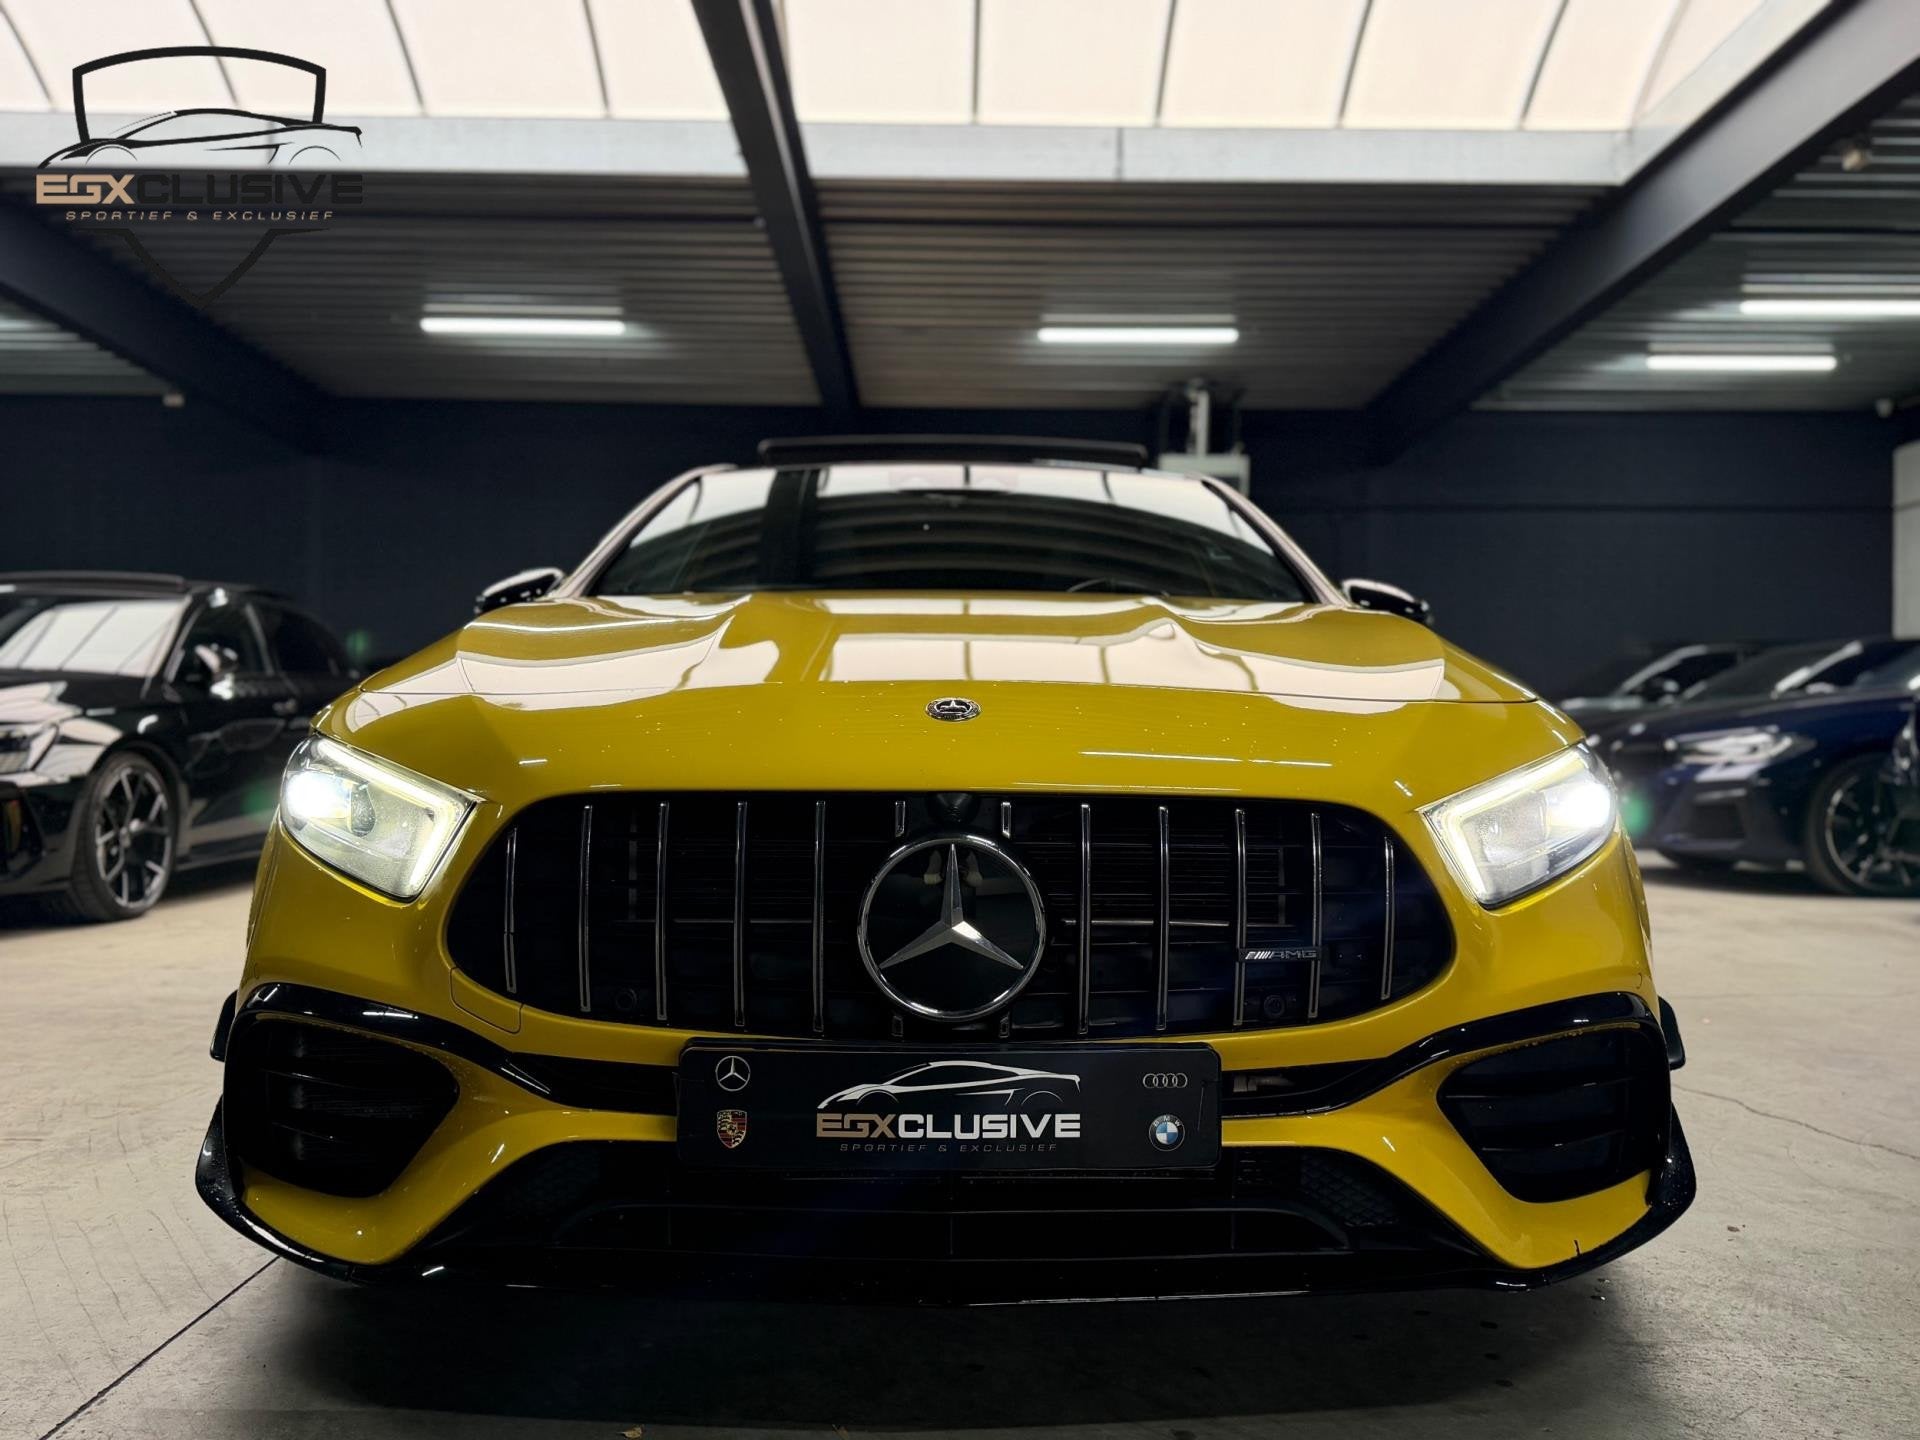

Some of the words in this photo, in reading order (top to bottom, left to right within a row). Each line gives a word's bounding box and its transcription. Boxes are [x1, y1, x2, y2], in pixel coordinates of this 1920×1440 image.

[816, 1113, 1081, 1140] EGXCLUSIVE
[839, 1143, 928, 1153] SPORTIEF
[938, 1143, 948, 1153] &
[959, 1143, 1058, 1153] EXCLUSIEF
